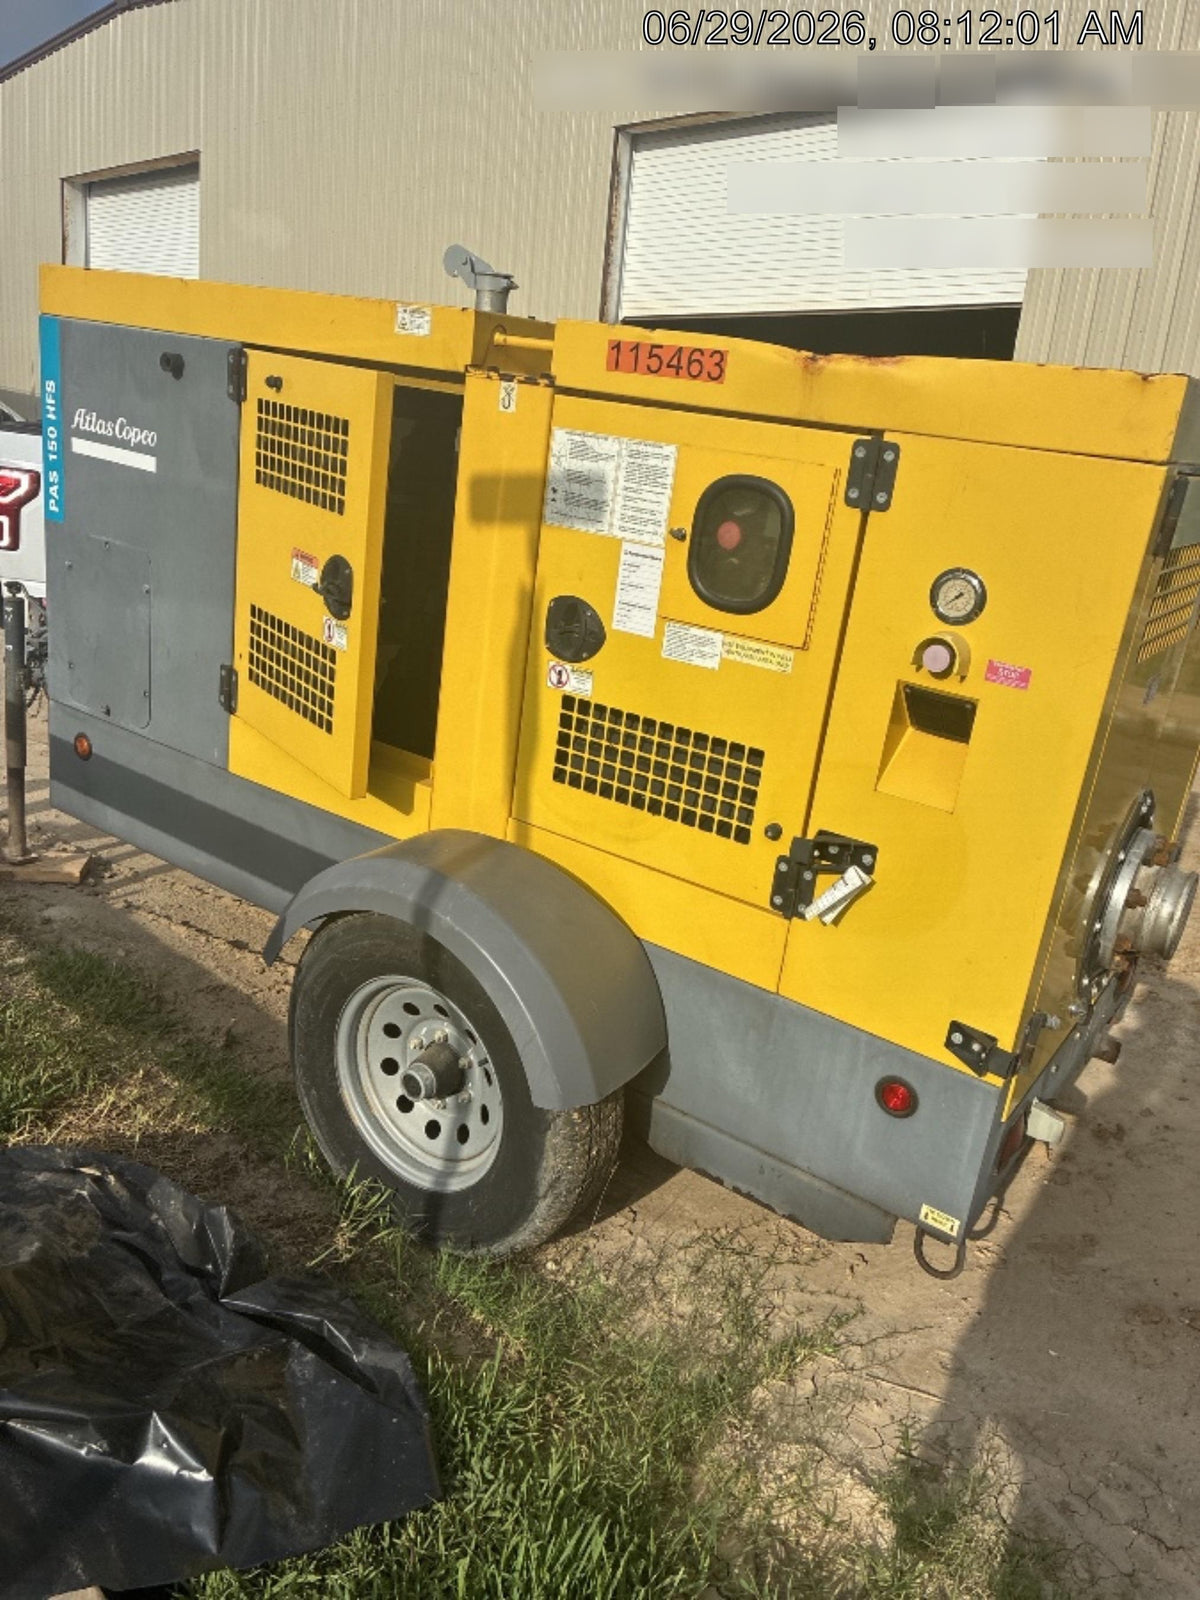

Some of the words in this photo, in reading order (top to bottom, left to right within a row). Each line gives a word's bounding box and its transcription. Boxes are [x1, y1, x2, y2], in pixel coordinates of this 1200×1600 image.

[610, 340, 725, 381] 115463
[45, 380, 57, 420] HFS
[47, 426, 58, 462] 150
[71, 408, 114, 437] Atlas
[115, 417, 158, 447] Copco
[48, 470, 60, 513] PAS
